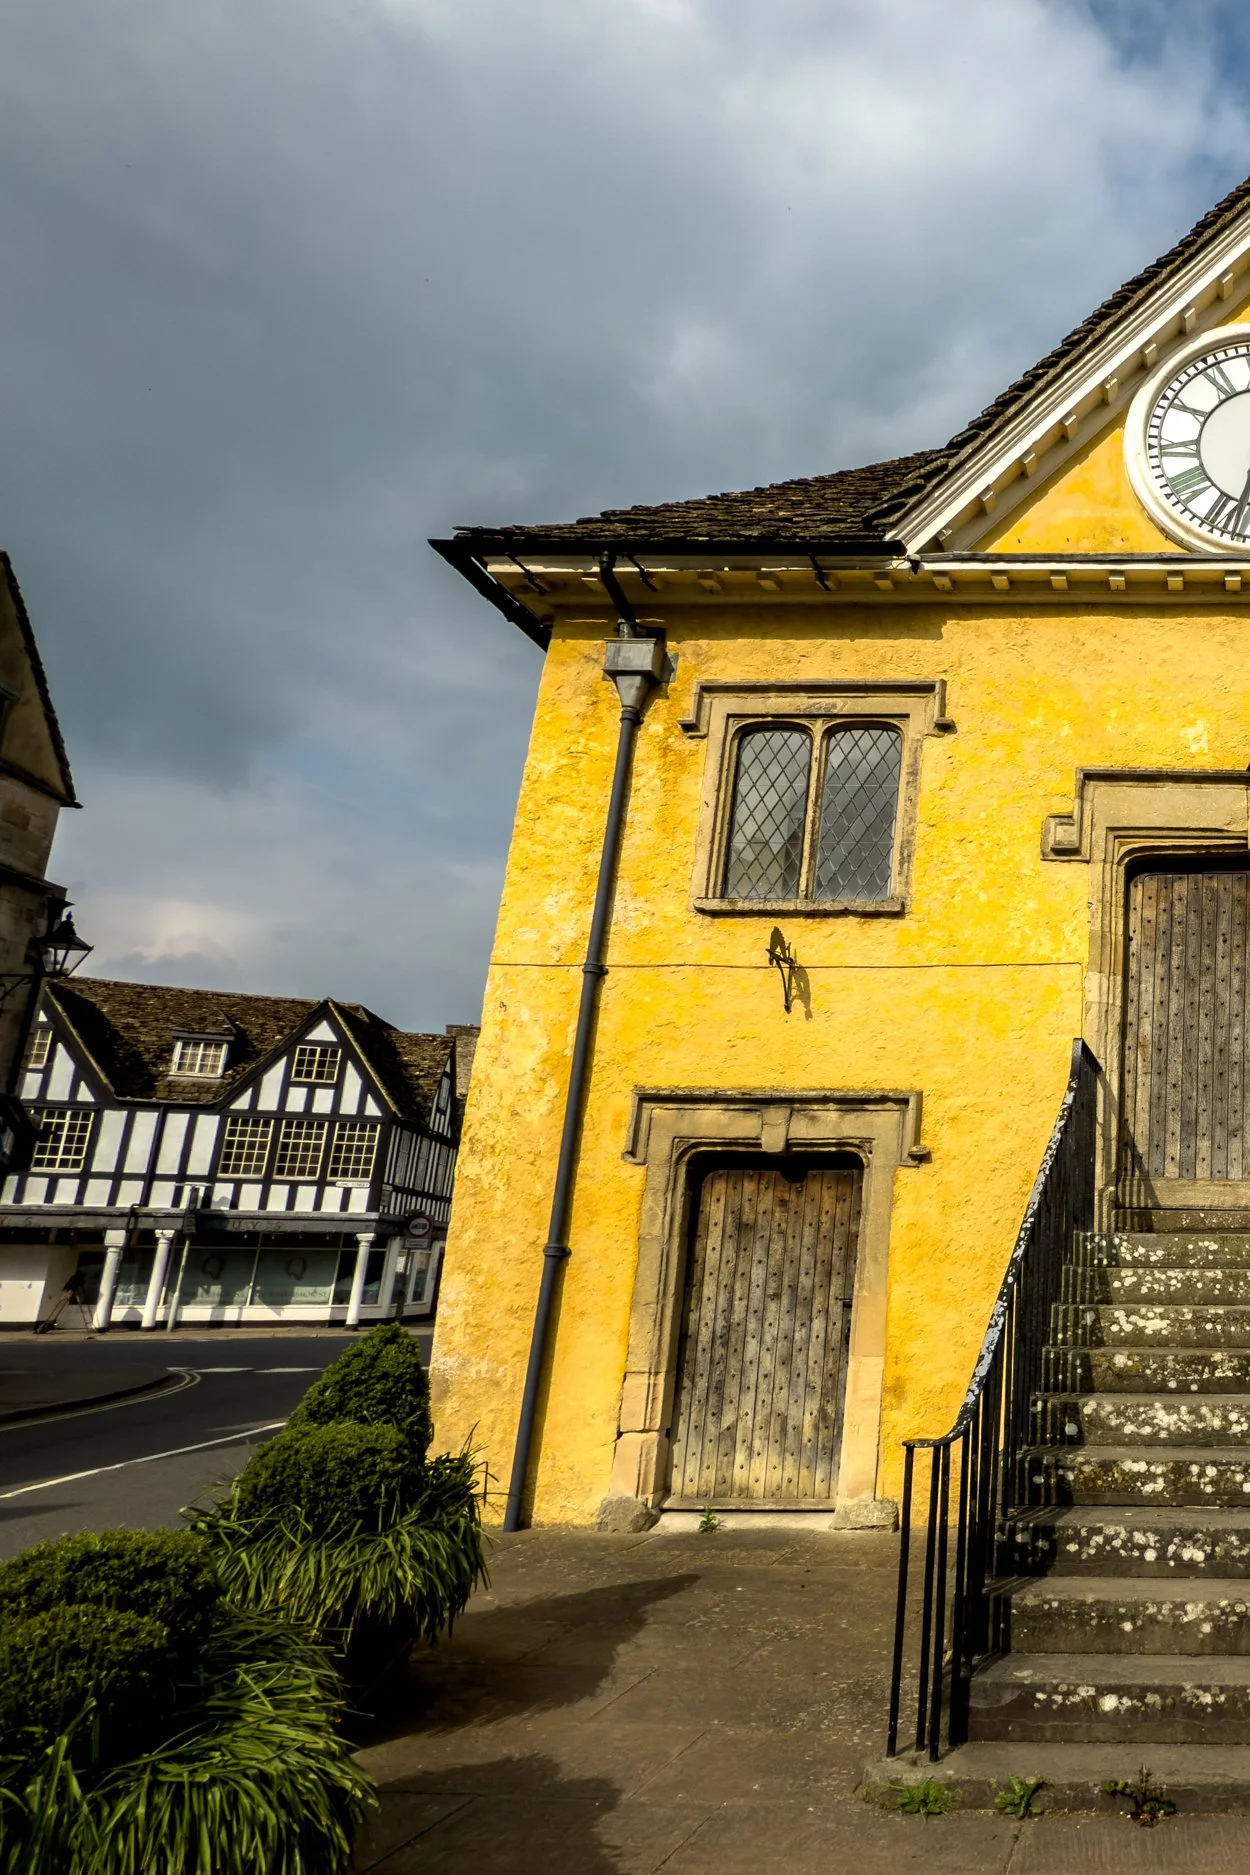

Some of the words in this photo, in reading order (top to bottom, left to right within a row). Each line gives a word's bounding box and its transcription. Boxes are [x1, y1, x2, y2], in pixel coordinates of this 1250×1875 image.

[1203, 364, 1237, 400] XI
[1171, 397, 1208, 425] X
[1161, 438, 1197, 457] IX
[1168, 466, 1212, 504] VIII
